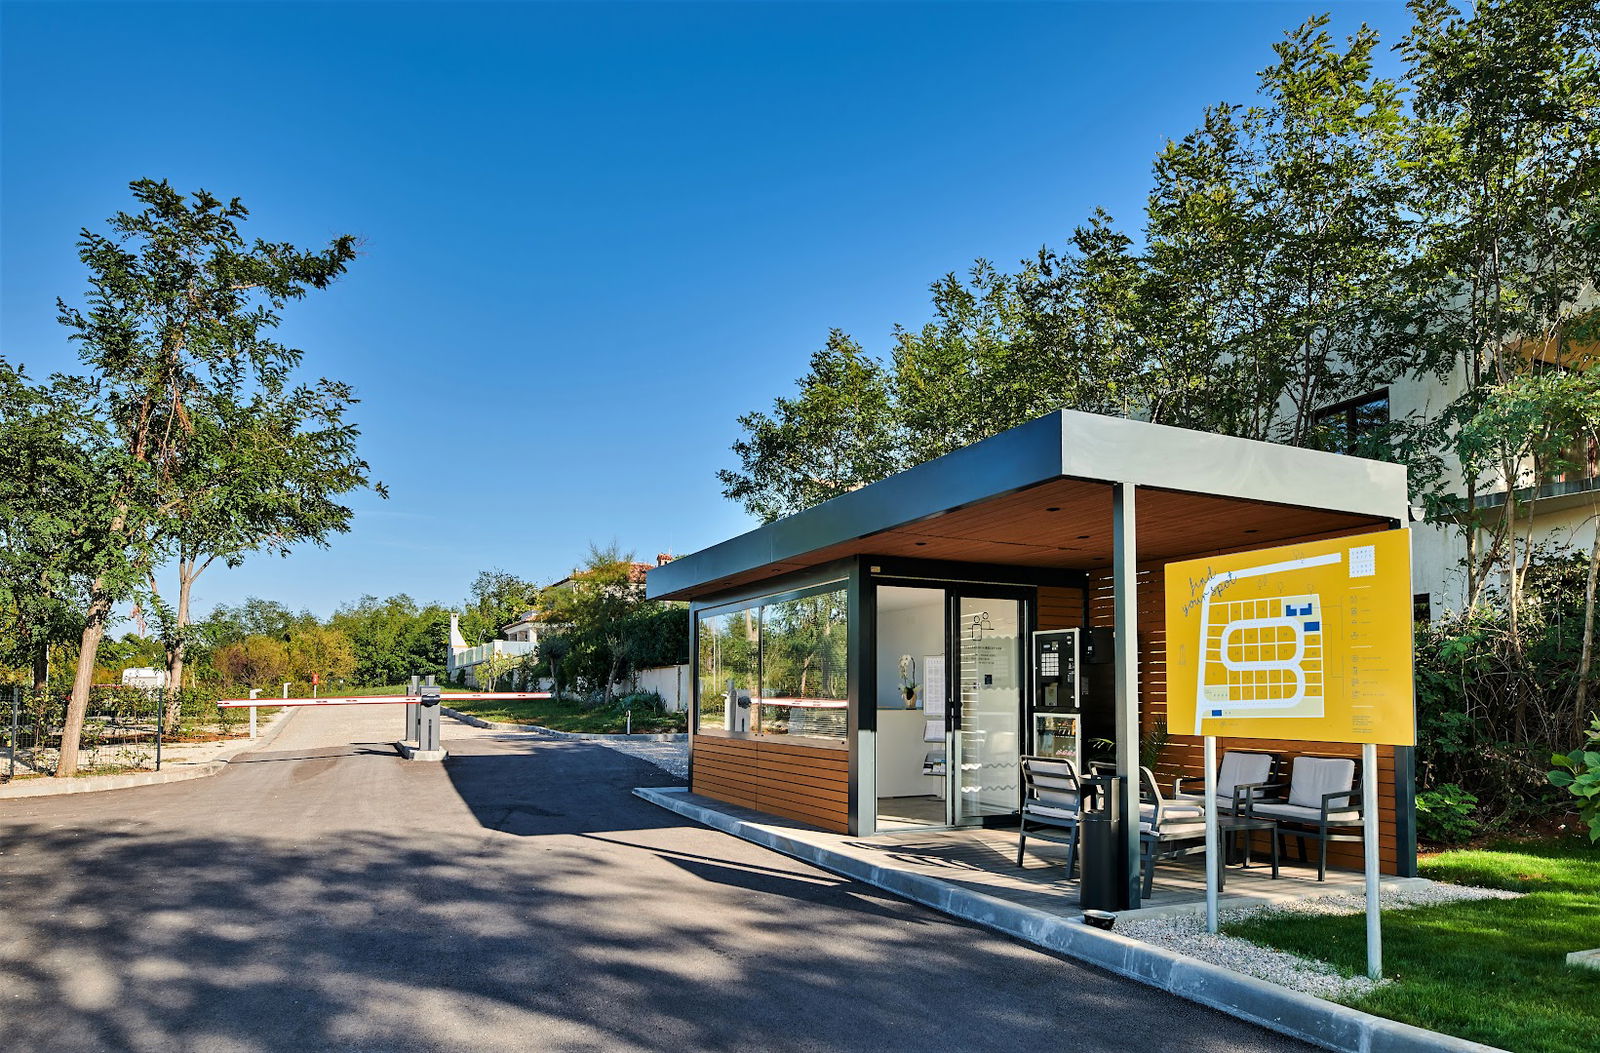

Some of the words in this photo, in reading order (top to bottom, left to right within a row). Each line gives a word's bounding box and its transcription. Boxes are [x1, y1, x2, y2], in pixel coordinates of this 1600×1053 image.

[1182, 591, 1209, 617] your
[1210, 571, 1237, 597] spot
[1189, 566, 1216, 597] find
